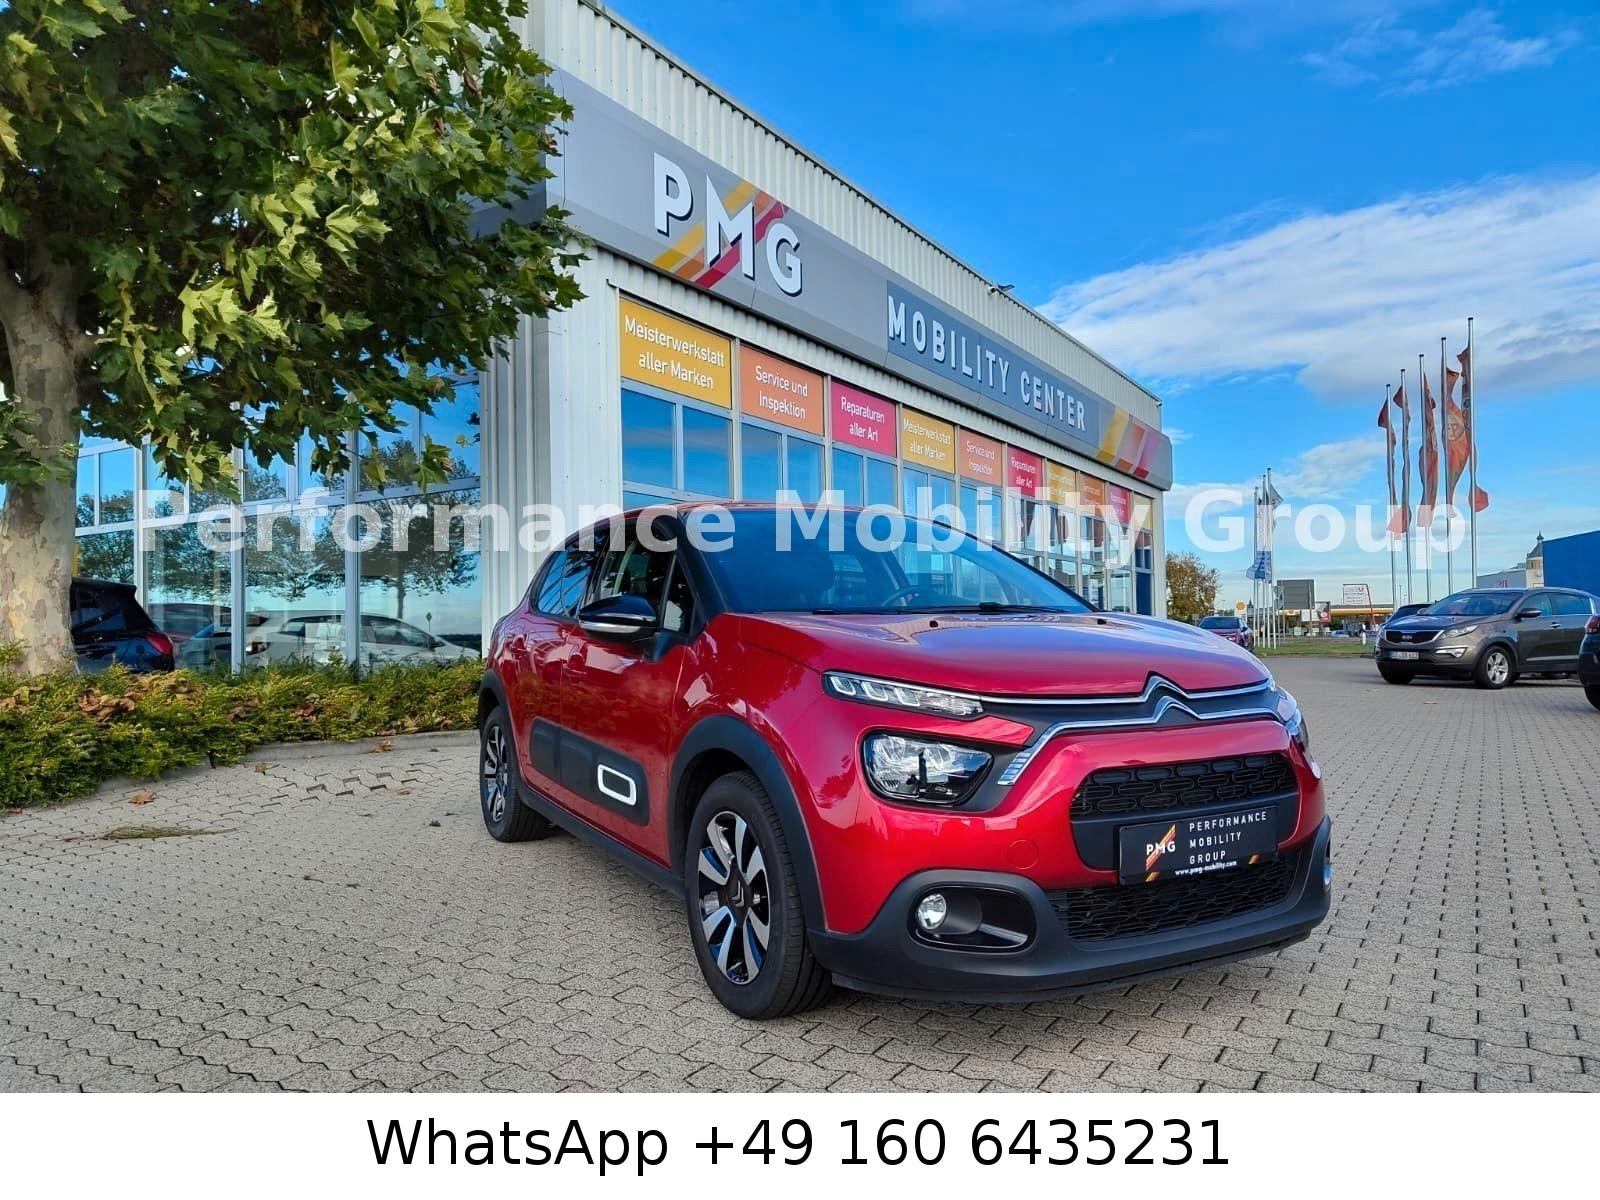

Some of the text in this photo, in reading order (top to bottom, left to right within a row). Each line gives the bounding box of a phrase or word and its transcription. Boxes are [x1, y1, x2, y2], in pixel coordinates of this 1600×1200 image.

[653, 151, 803, 298] PMG
[624, 315, 725, 368] Meisterwerkstatt
[638, 351, 714, 390] aller Marken
[887, 295, 1086, 432] MOBILITY CENTER
[755, 365, 808, 397] Service und
[759, 391, 806, 420] Inspektion
[841, 396, 885, 425] Reparaturen
[849, 422, 879, 442] aller Art
[1189, 811, 1267, 833] PERFORMANCE
[1146, 831, 1242, 855] PMG MOBILITY
[1189, 850, 1226, 865] GROUP
[1175, 860, 1237, 876] www.pmg-mobility.com
